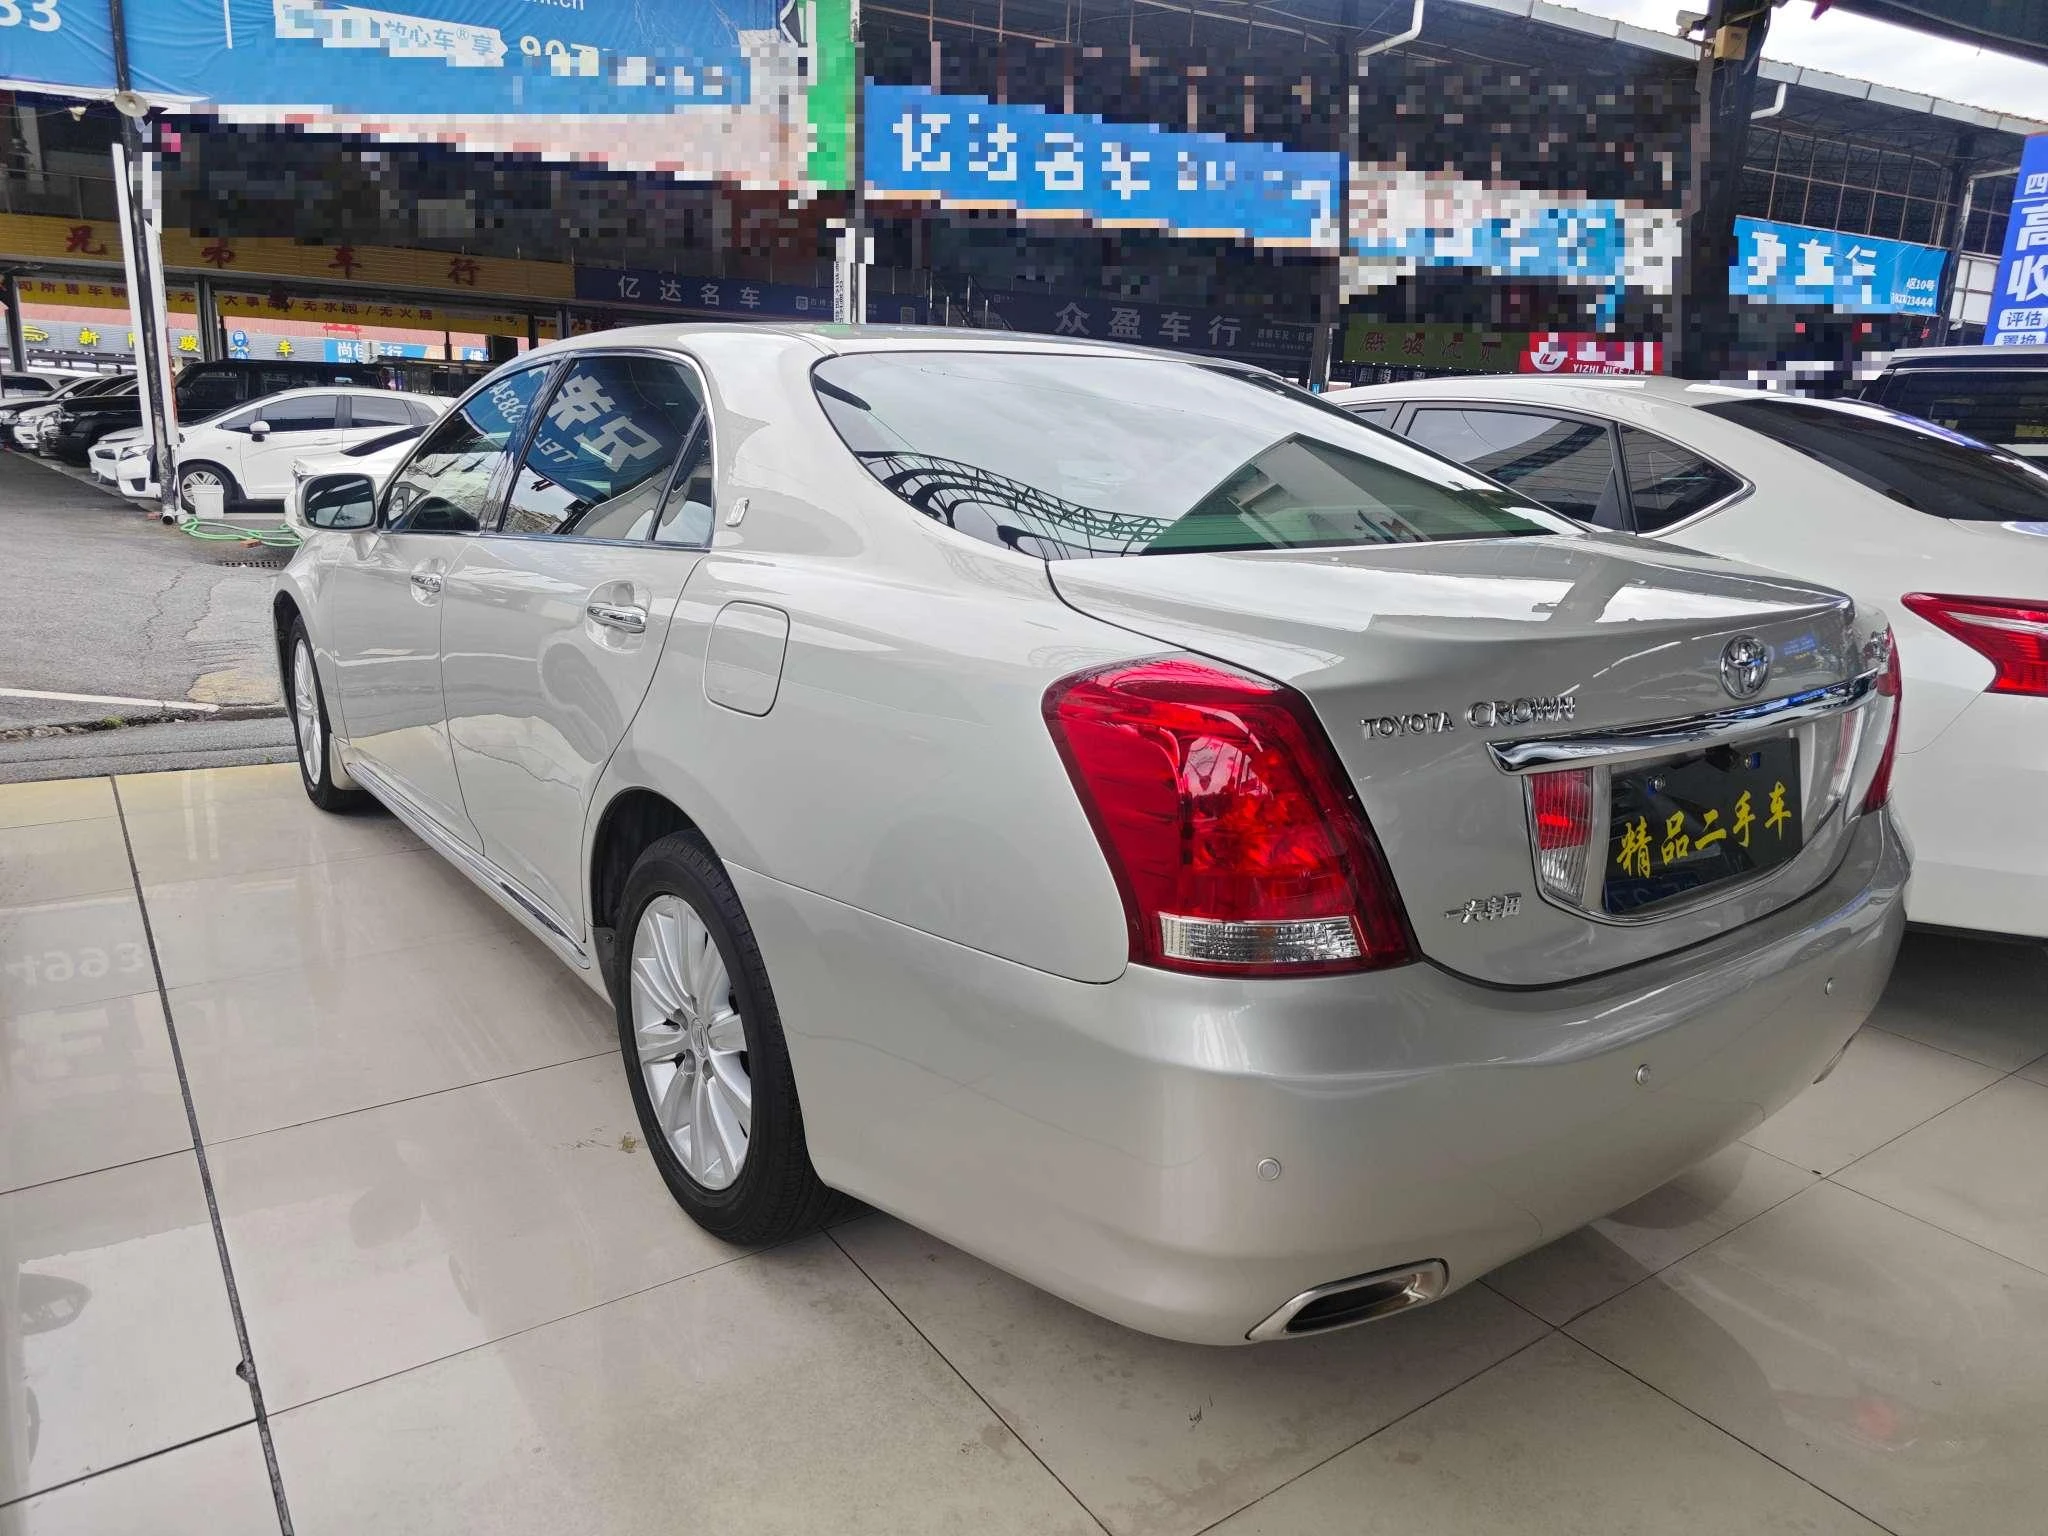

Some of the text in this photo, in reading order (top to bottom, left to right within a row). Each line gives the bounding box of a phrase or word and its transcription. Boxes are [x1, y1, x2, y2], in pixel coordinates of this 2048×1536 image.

[618, 275, 761, 308] 亿达名车
[1055, 302, 1243, 347] 众盈车行
[1572, 363, 1599, 374] YIZHI
[1360, 695, 1577, 740] TOYOTA CROWN
[1616, 779, 1793, 880] 精品二手车
